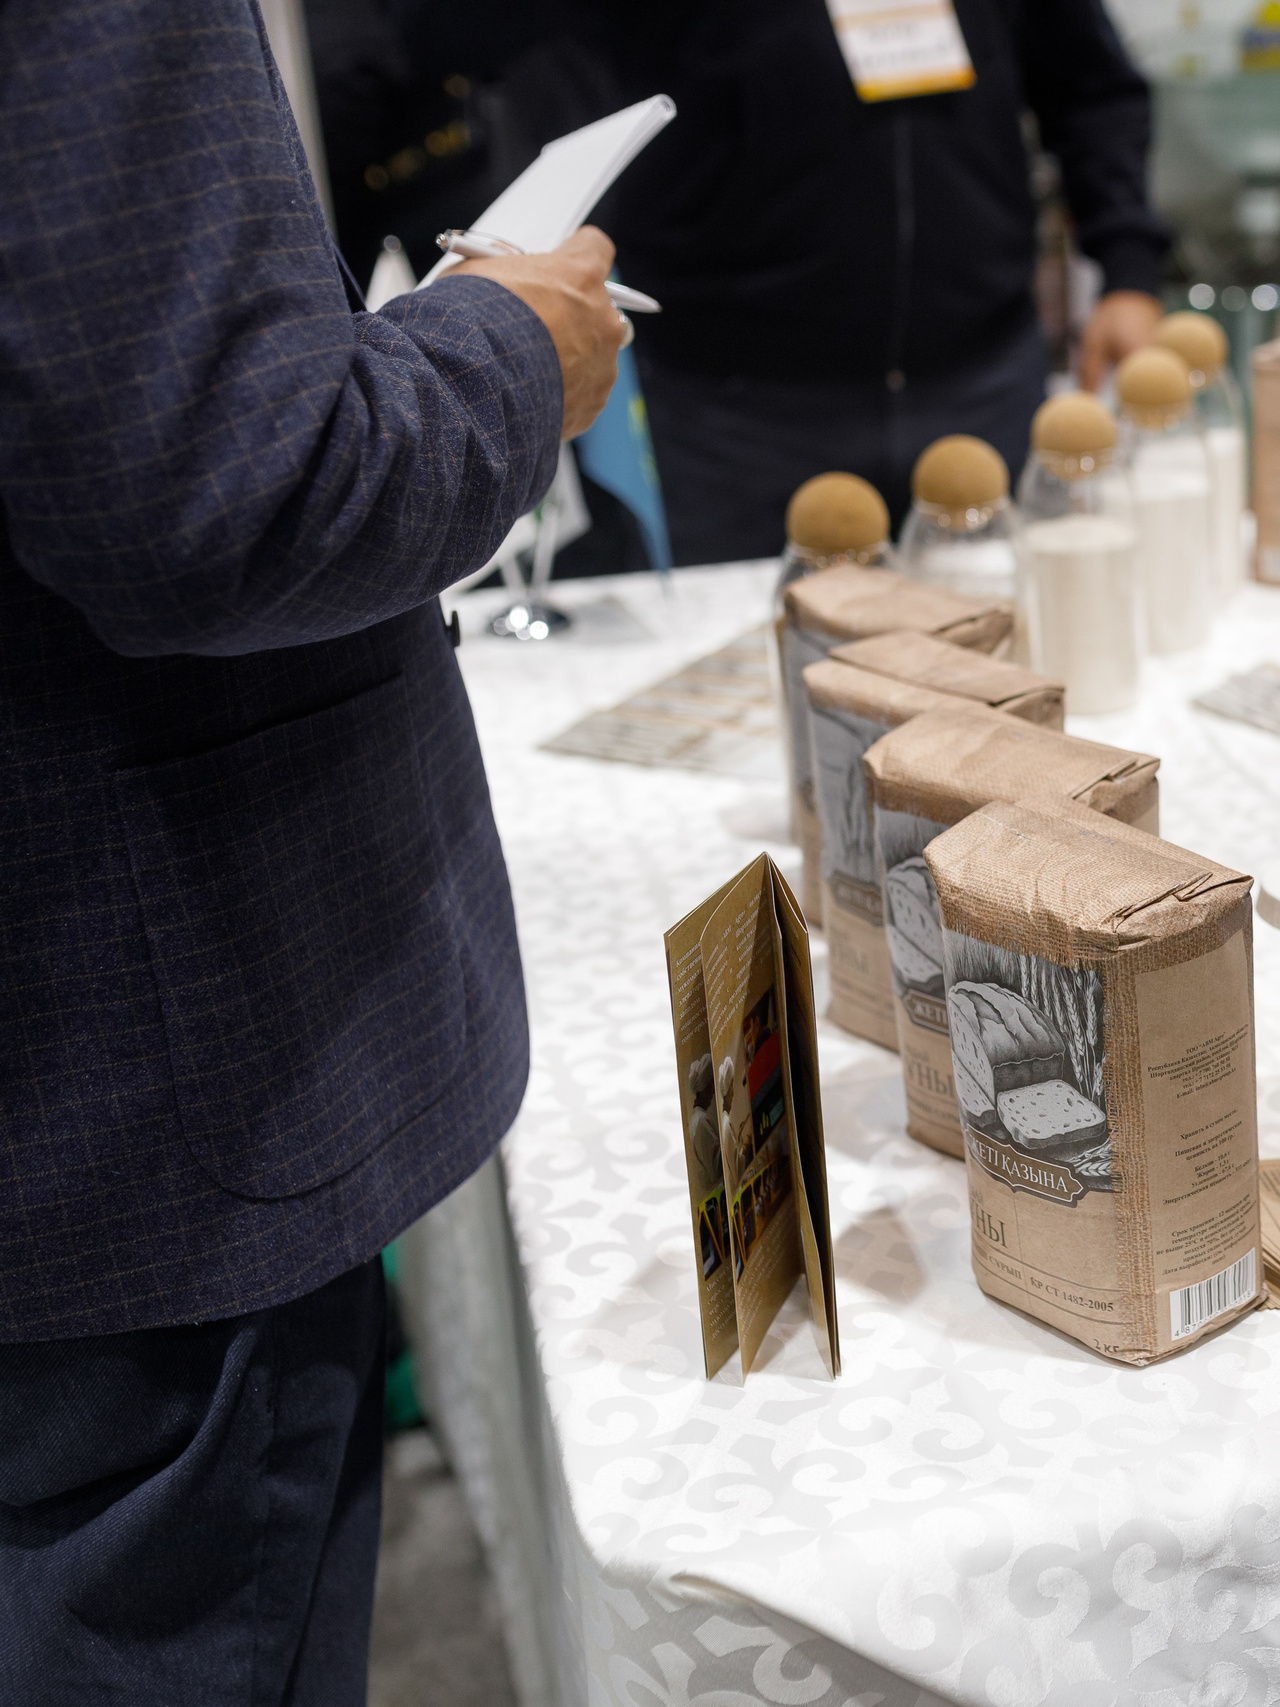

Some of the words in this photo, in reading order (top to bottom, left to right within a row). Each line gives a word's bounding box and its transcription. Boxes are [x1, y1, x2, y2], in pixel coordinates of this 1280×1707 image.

[1148, 1060, 1181, 1072] Республика
[1180, 1128, 1205, 1140] Хранить
[1175, 1144, 1202, 1157] Пищевая
[1002, 1153, 1068, 1193] ҚАЗЫНА
[1163, 1184, 1209, 1205] Энергетическая
[1171, 1228, 1188, 1238] Срок
[1189, 1217, 1215, 1232] хранения
[1171, 1227, 1208, 1245] температуре
[1165, 1244, 1184, 1254] выше
[1184, 1244, 1206, 1255] воздуха
[1183, 1250, 1207, 1263] прямых
[1162, 1267, 1178, 1275] Дата
[1063, 1292, 1114, 1312] 1482-2005
[1093, 1338, 1101, 1350] 2
